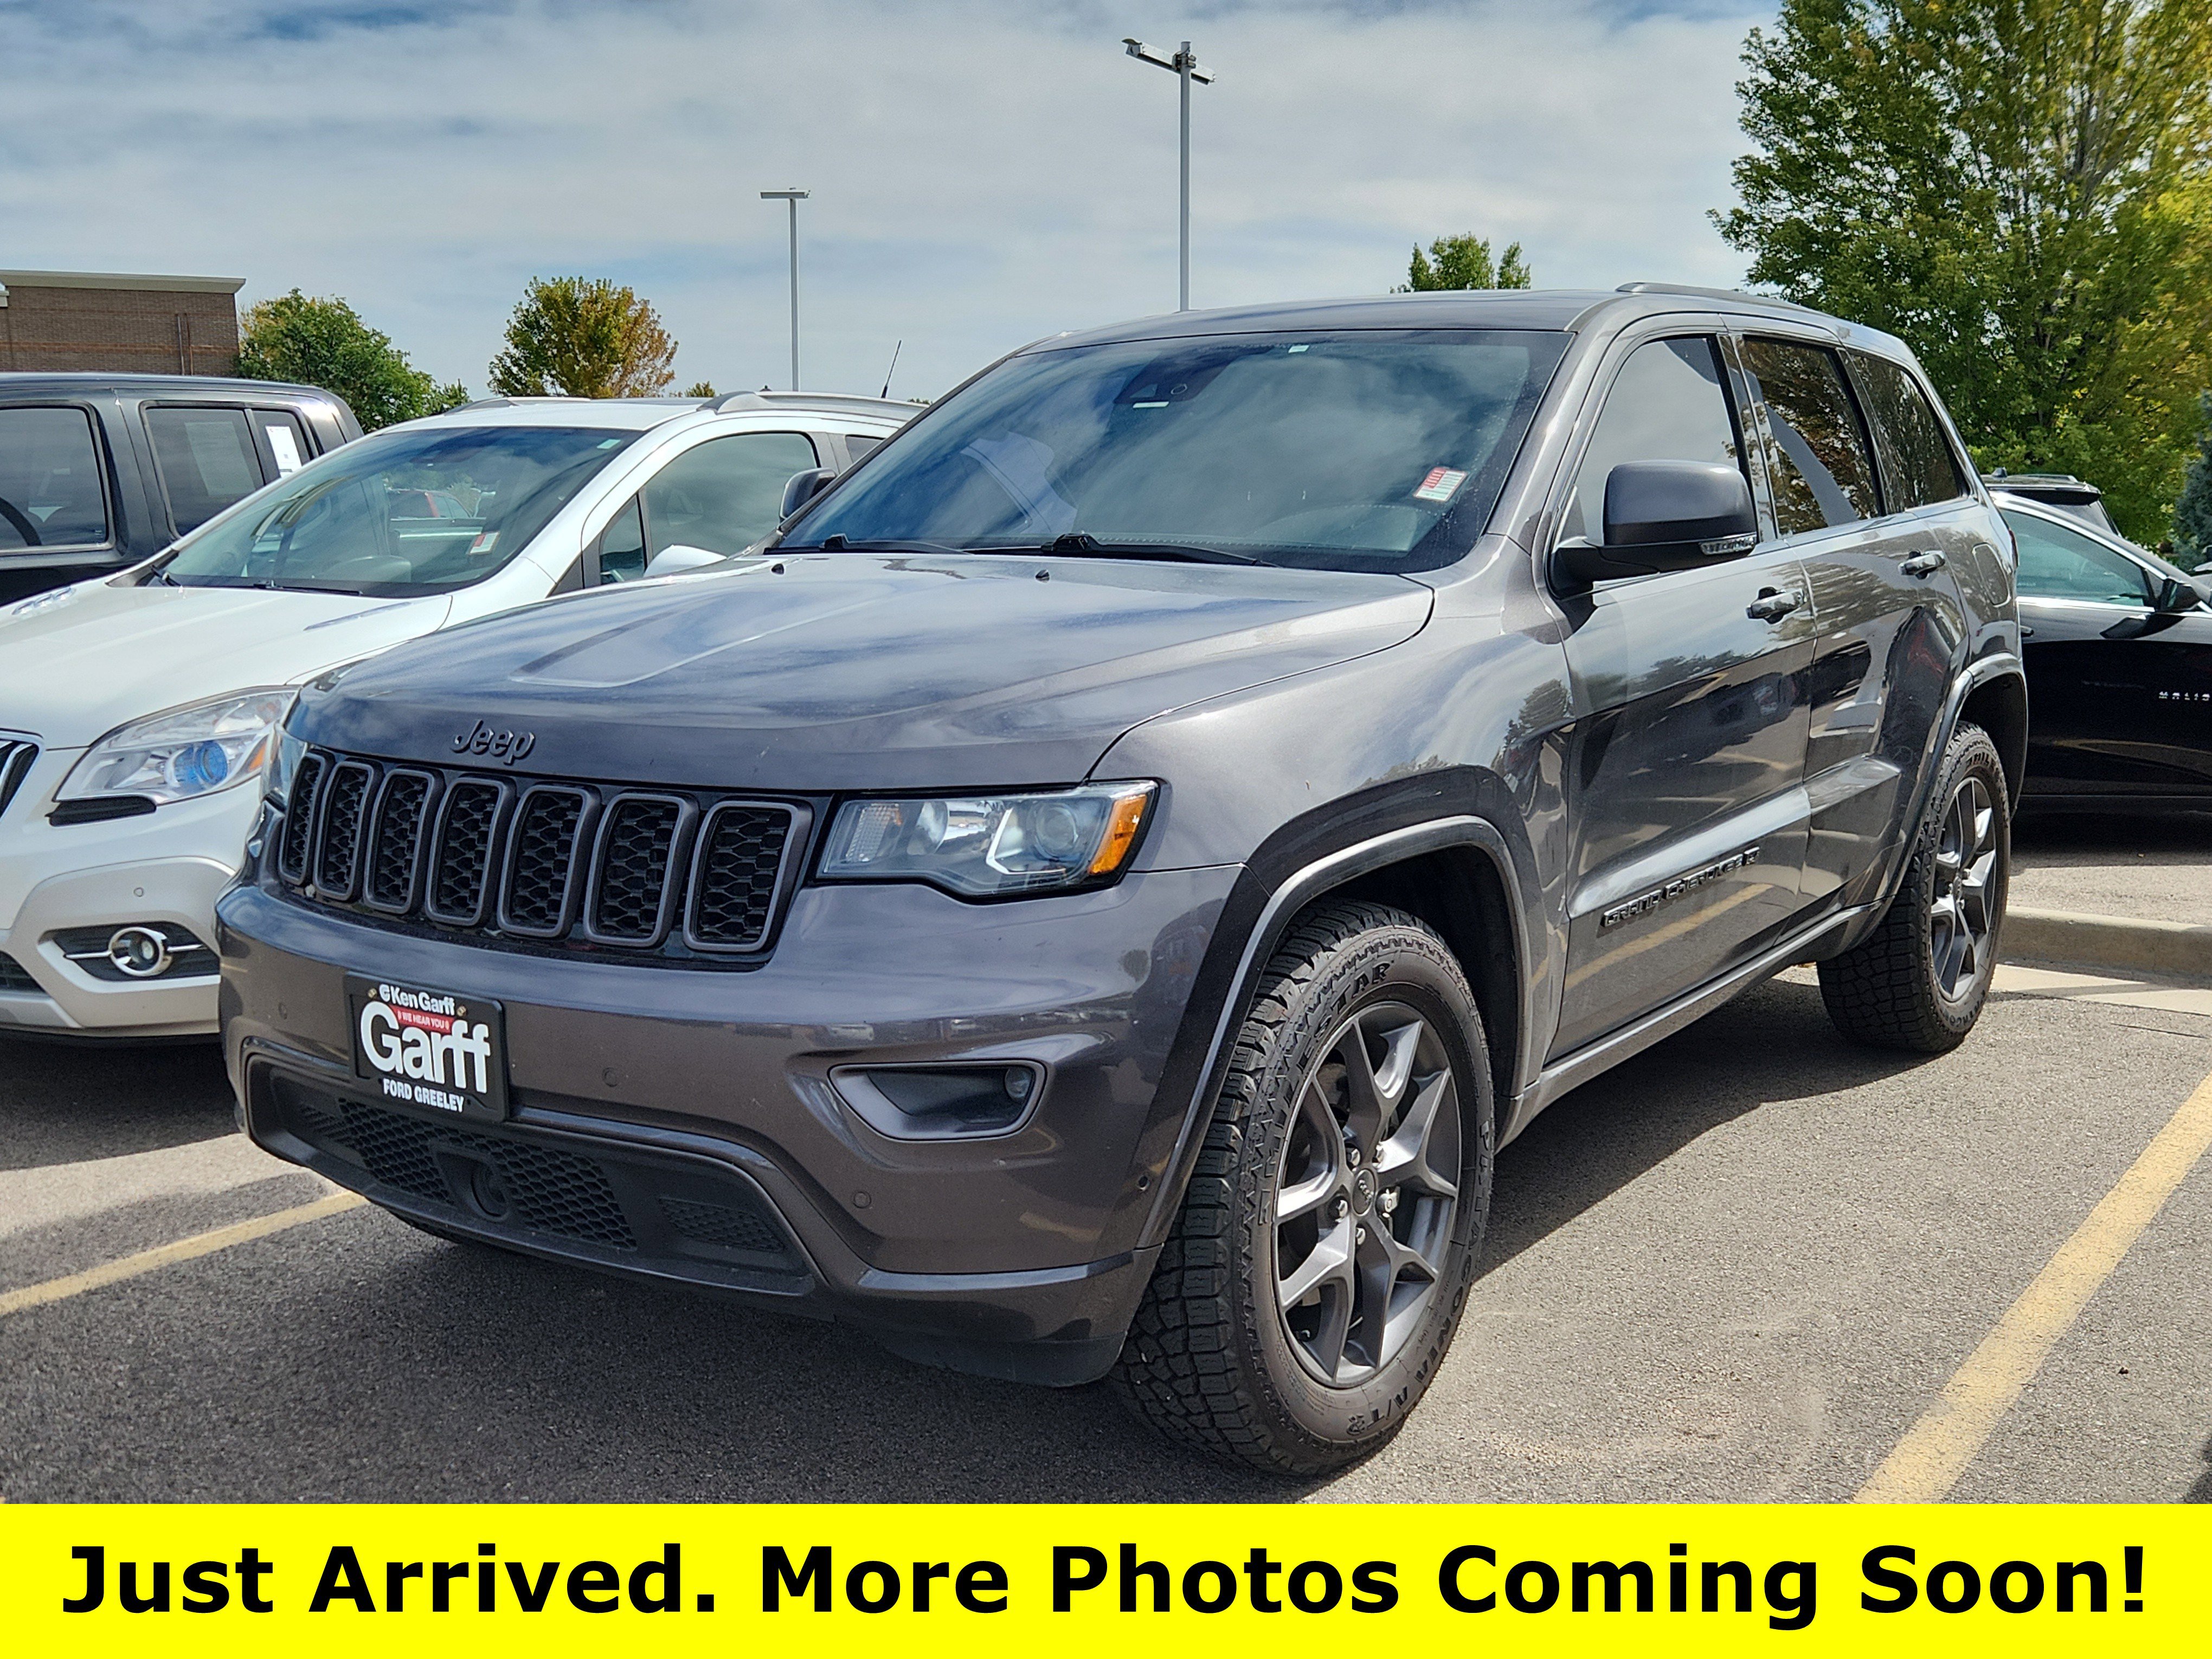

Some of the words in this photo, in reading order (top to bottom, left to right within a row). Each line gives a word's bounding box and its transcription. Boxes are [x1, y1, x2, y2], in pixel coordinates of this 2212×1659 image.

[451, 719, 536, 766] Jeep
[1600, 890, 1662, 927] GRAND
[390, 986, 419, 1009] Ken
[419, 992, 455, 1016] Garff
[361, 1001, 491, 1094] Garff
[383, 1078, 412, 1101] FORD
[414, 1085, 464, 1113] GREELEY
